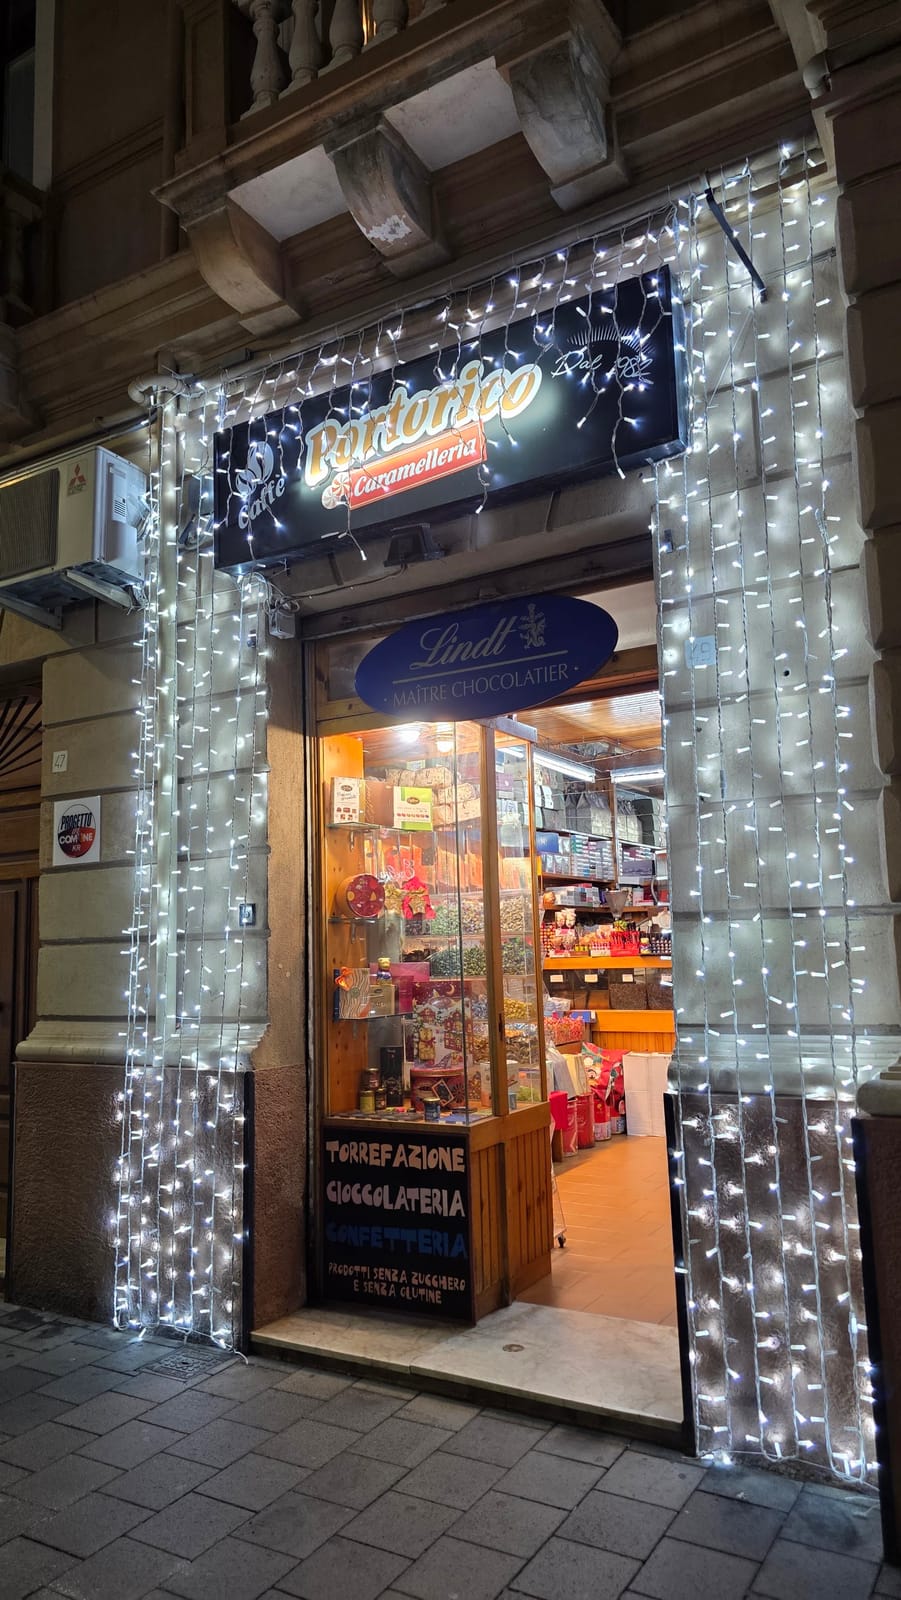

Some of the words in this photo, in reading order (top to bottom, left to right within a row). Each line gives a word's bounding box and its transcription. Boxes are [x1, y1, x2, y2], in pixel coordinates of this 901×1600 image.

[551, 350, 603, 378] Dal
[613, 355, 653, 378] 982
[306, 361, 541, 484] Portorico
[353, 438, 478, 498] Caramelleria
[410, 615, 518, 670] Lindt
[392, 683, 448, 708] MAÎTRE
[451, 663, 569, 698] CHOCOLATIER
[54, 753, 66, 769] 47
[60, 811, 93, 830] PROGETTO
[325, 1139, 466, 1173] TORREFAZIONE
[325, 1180, 466, 1217] CIOCCOLATERIA
[325, 1222, 468, 1259] CONFETTERIA
[327, 1261, 371, 1280] PRODOTTI
[373, 1266, 408, 1284] SENZA
[411, 1271, 466, 1292] ZUCCHERO
[353, 1280, 360, 1292] E
[363, 1280, 396, 1297] SENZA
[400, 1286, 442, 1304] GLUTINE
